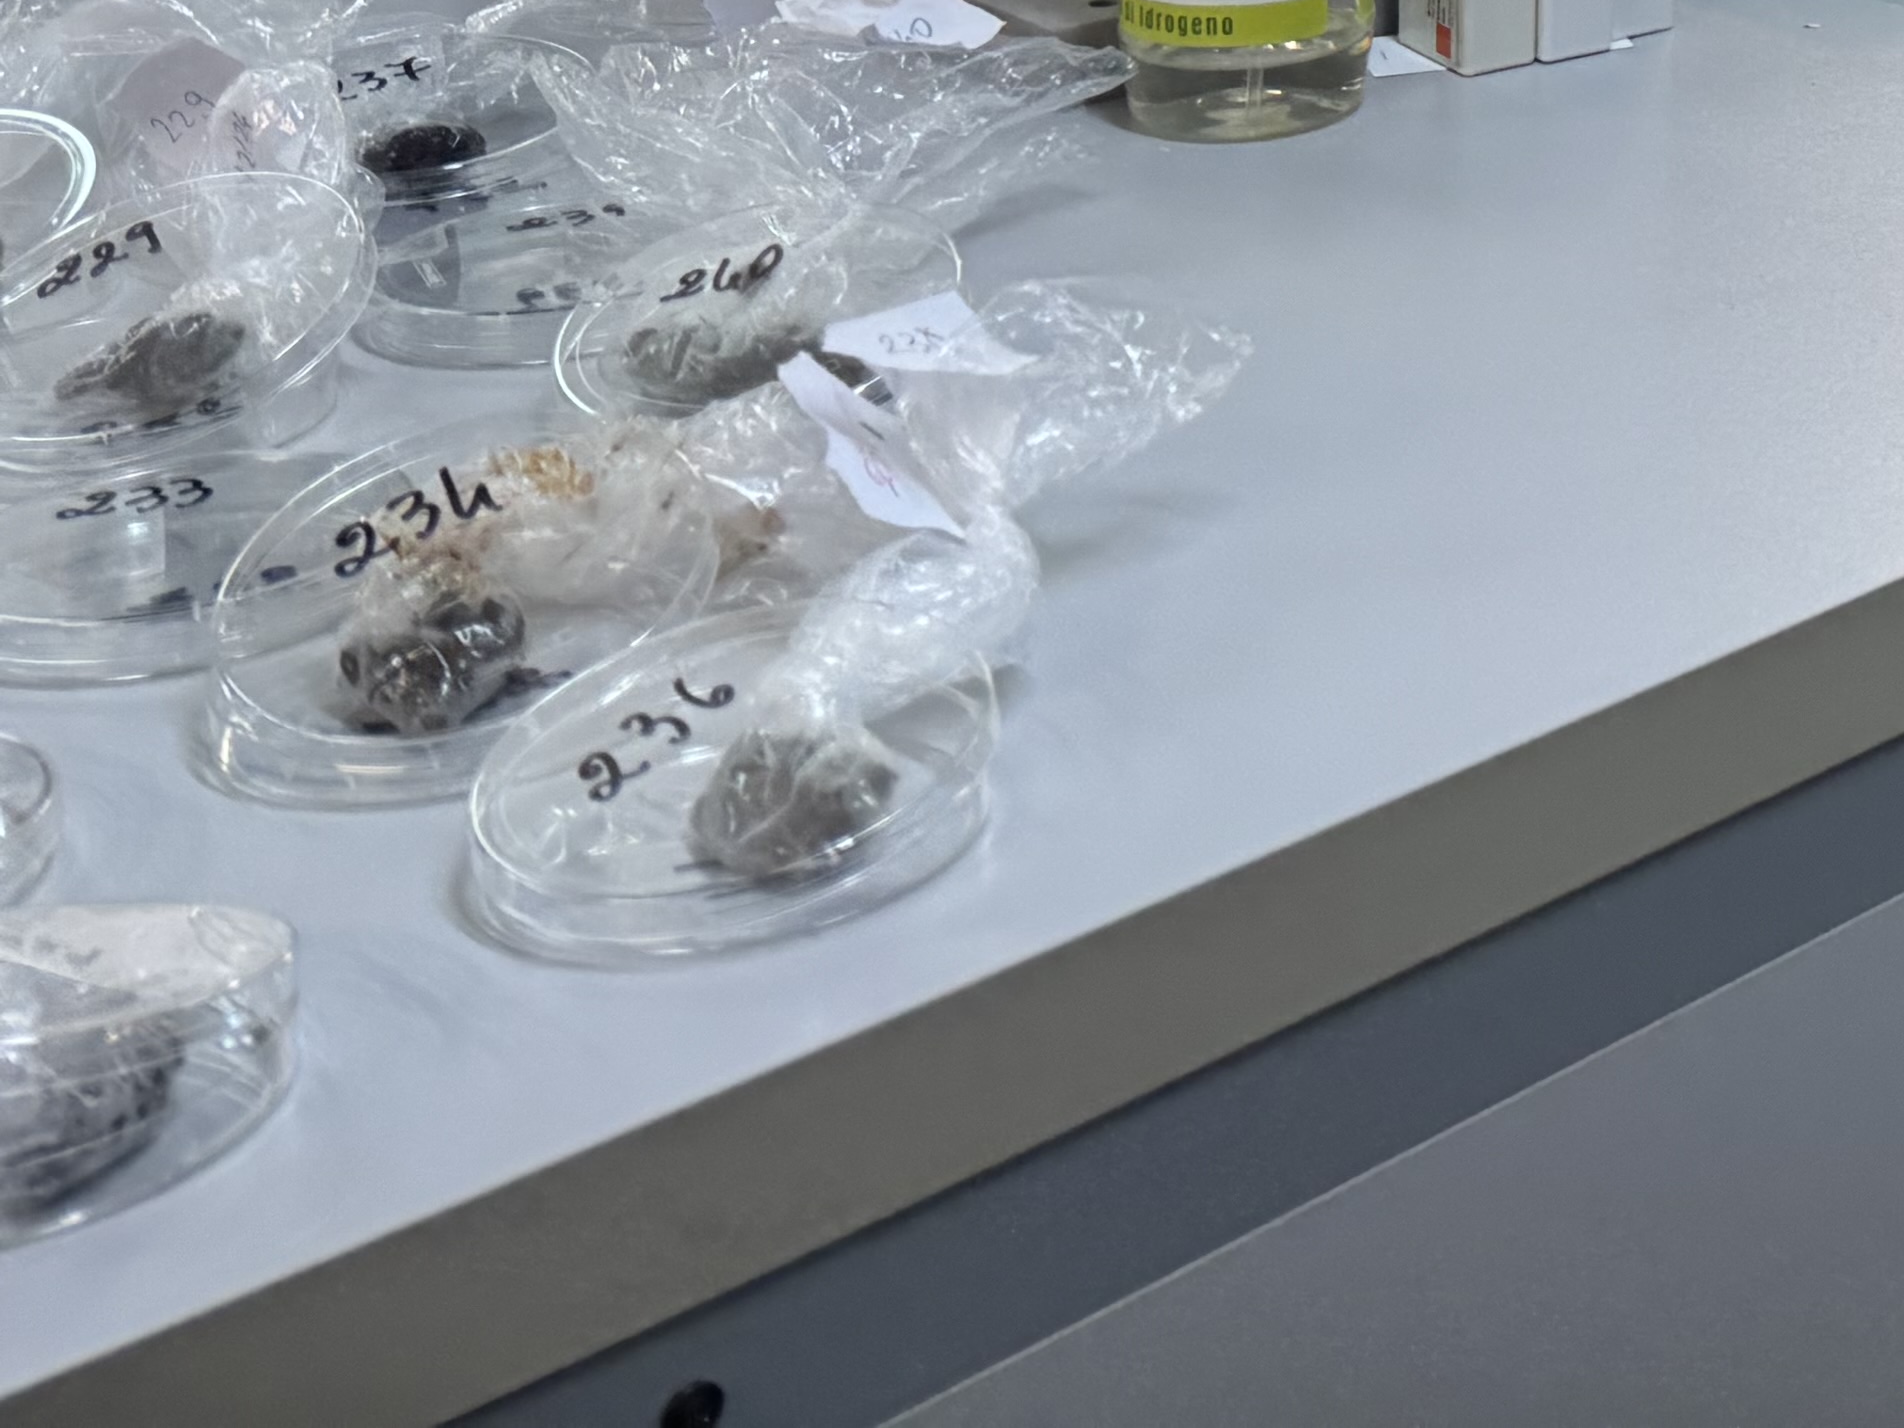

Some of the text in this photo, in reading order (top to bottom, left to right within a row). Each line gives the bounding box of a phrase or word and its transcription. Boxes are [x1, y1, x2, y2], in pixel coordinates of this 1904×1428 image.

[1139, 4, 1234, 38] Idrogeno
[37, 220, 163, 300] 229
[659, 243, 785, 303] 240
[55, 478, 214, 521] 233
[333, 465, 503, 578] 234
[577, 676, 736, 803] 236
